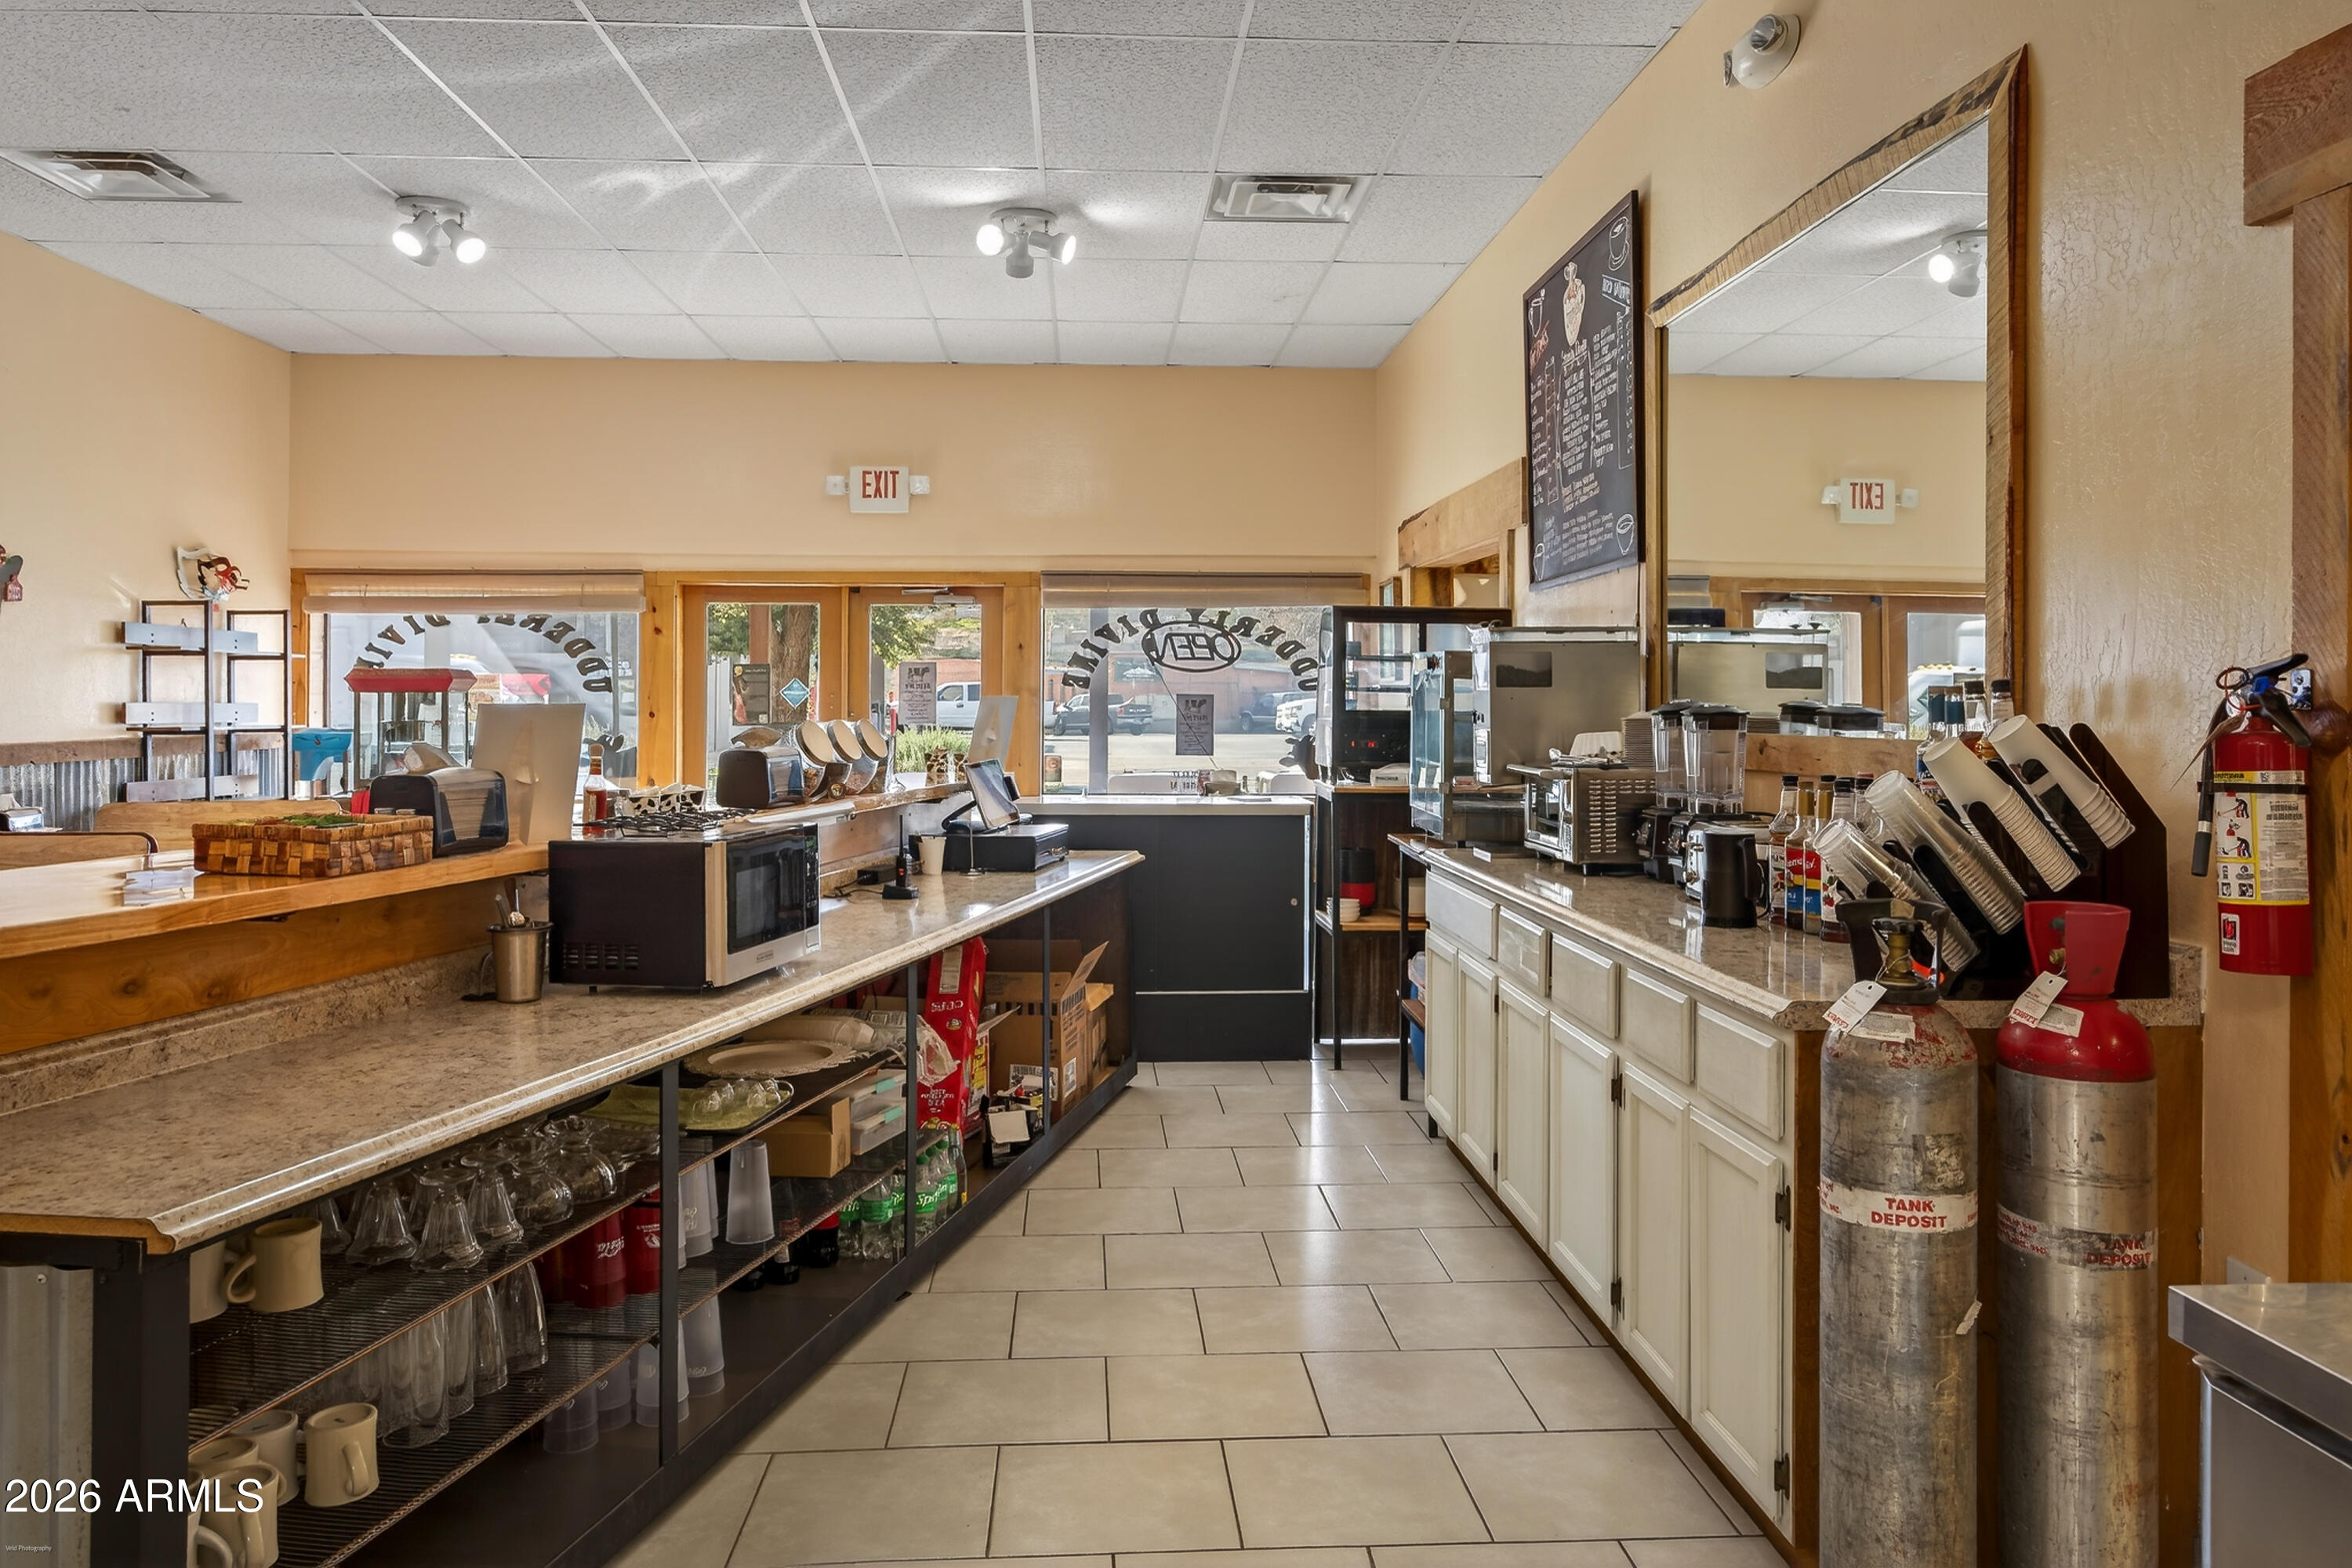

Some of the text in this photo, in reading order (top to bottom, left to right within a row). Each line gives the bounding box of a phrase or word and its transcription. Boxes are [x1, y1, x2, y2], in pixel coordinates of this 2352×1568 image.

[862, 470, 899, 499] EXIT
[1885, 1197, 1934, 1213] TANK
[1871, 1211, 1947, 1229] DEPOSIT
